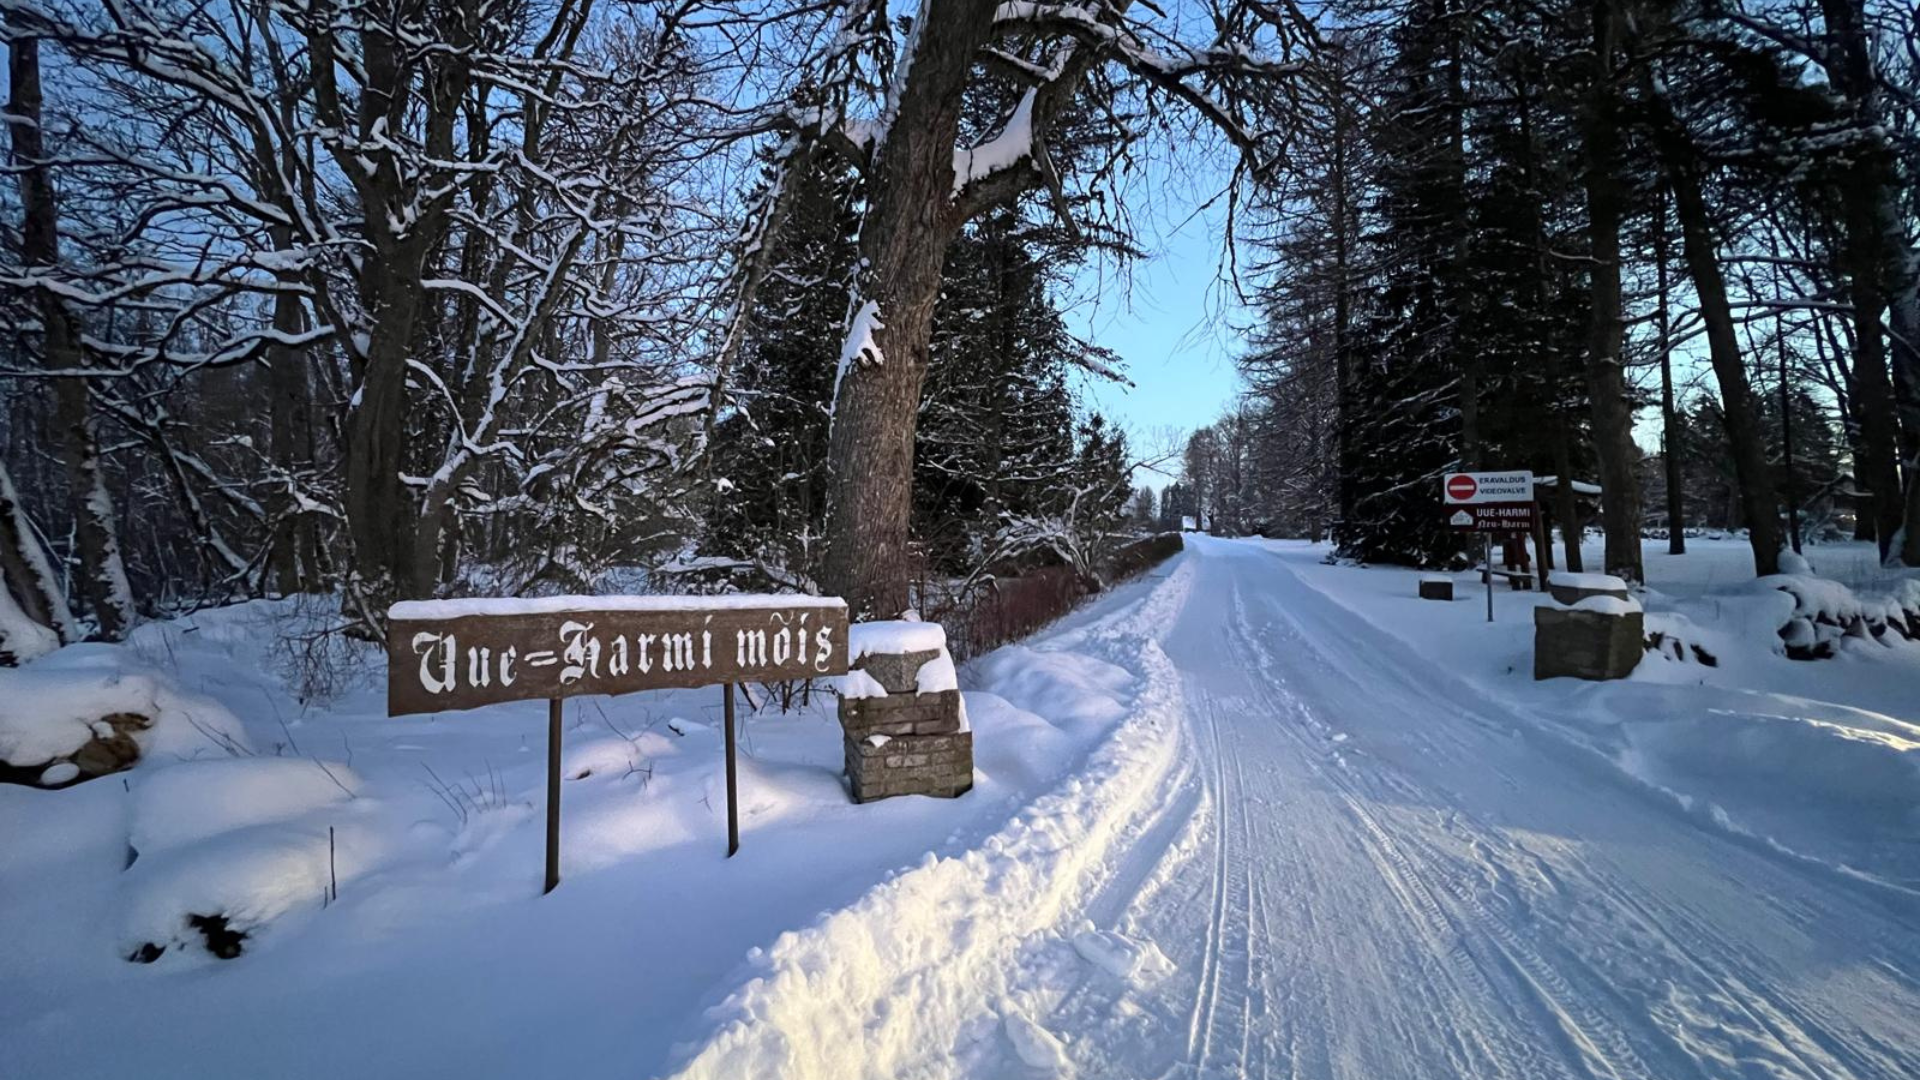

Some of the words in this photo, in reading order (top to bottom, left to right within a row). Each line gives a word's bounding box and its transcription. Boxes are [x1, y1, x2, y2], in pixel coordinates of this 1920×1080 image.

[1479, 476, 1526, 484] ERAVALDUS
[1480, 487, 1526, 495] VIDEOVALVE
[1476, 508, 1531, 517] UUE-HARMI
[736, 611, 833, 673] mõis
